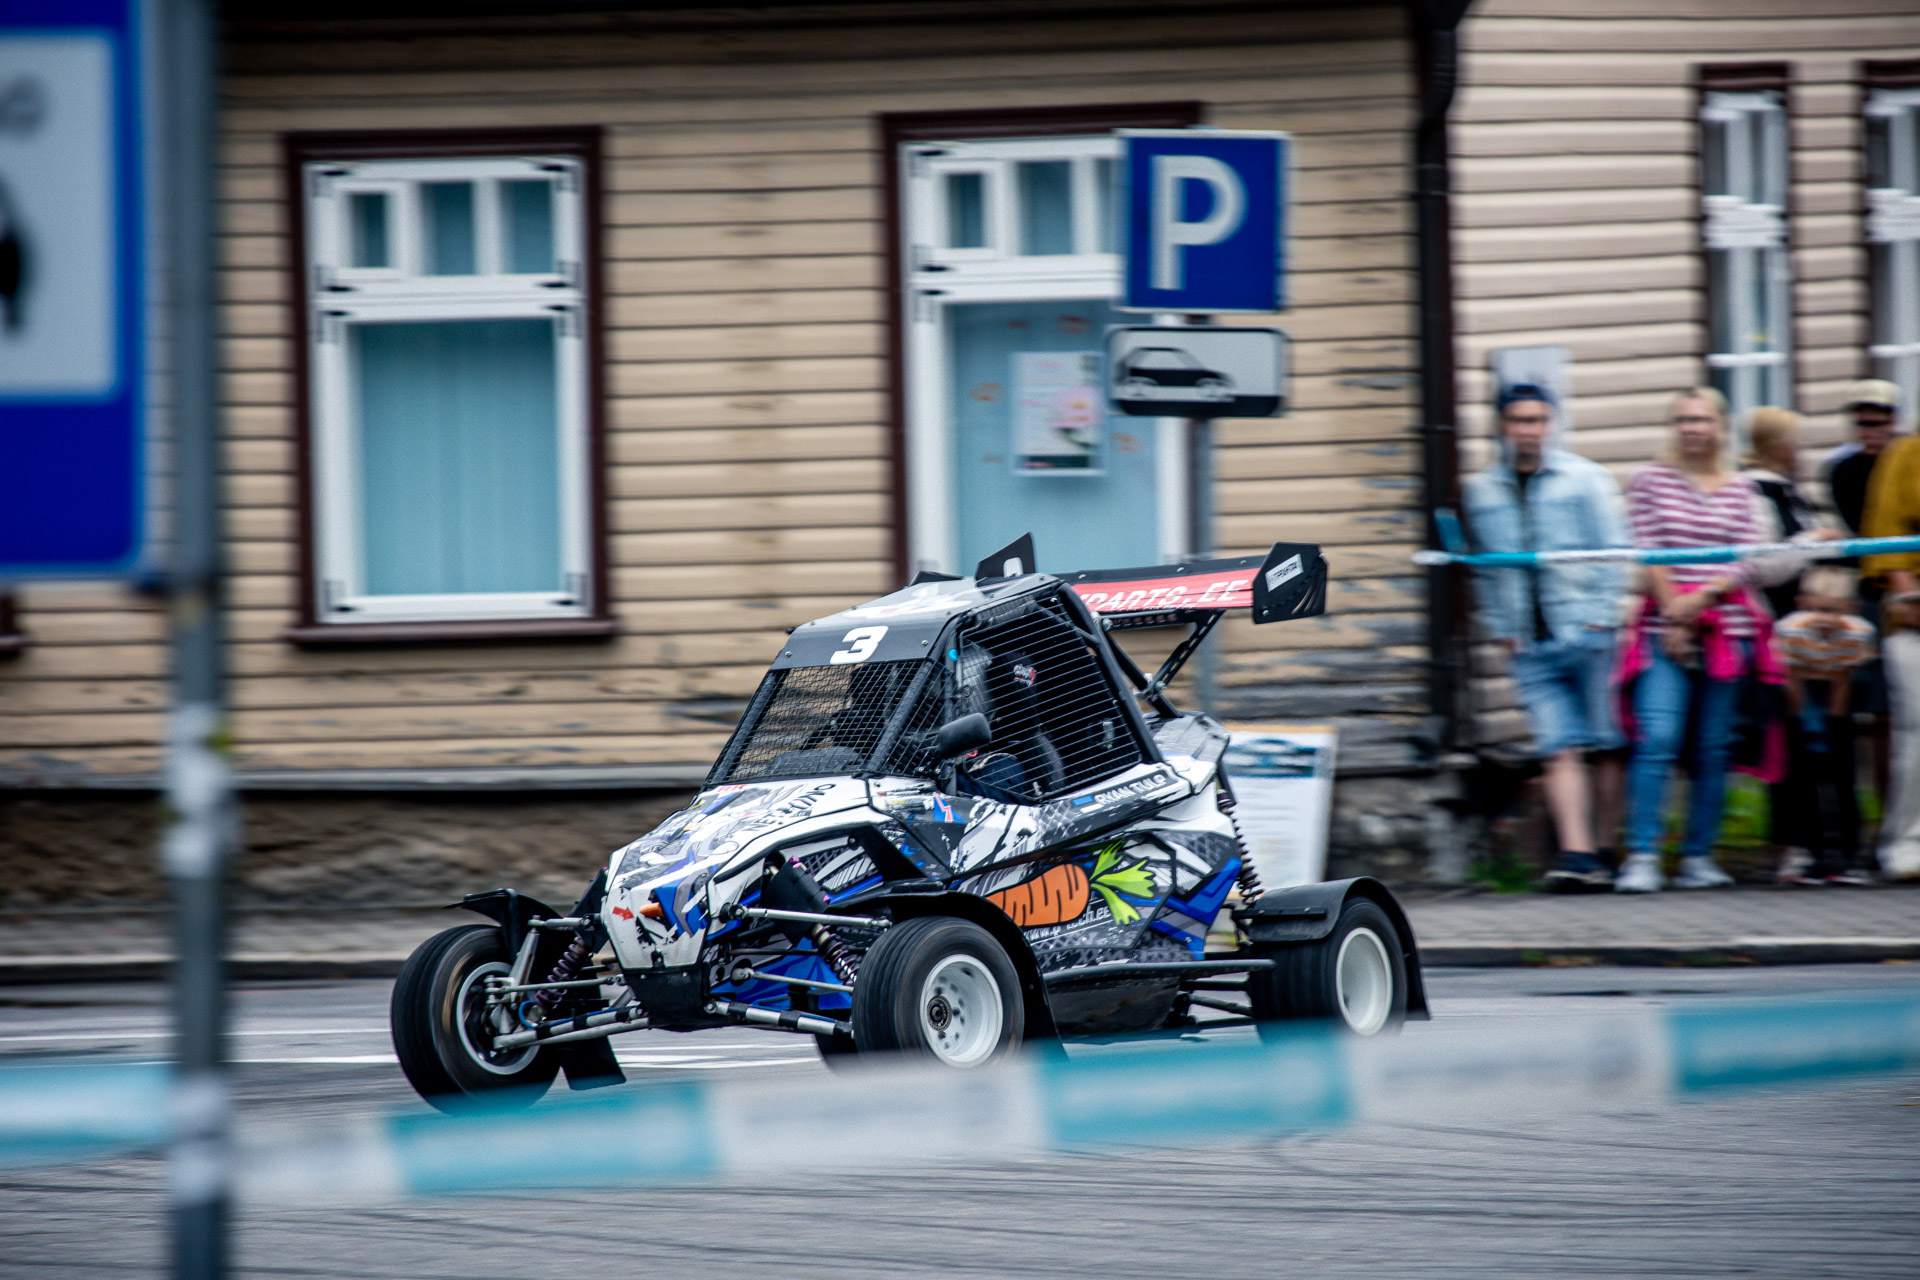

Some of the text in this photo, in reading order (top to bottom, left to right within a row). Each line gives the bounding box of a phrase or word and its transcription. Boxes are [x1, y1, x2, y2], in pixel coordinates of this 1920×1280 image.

[1149, 154, 1249, 291] P
[1079, 579, 1249, 612] PARTS.EE
[830, 625, 888, 664] 3
